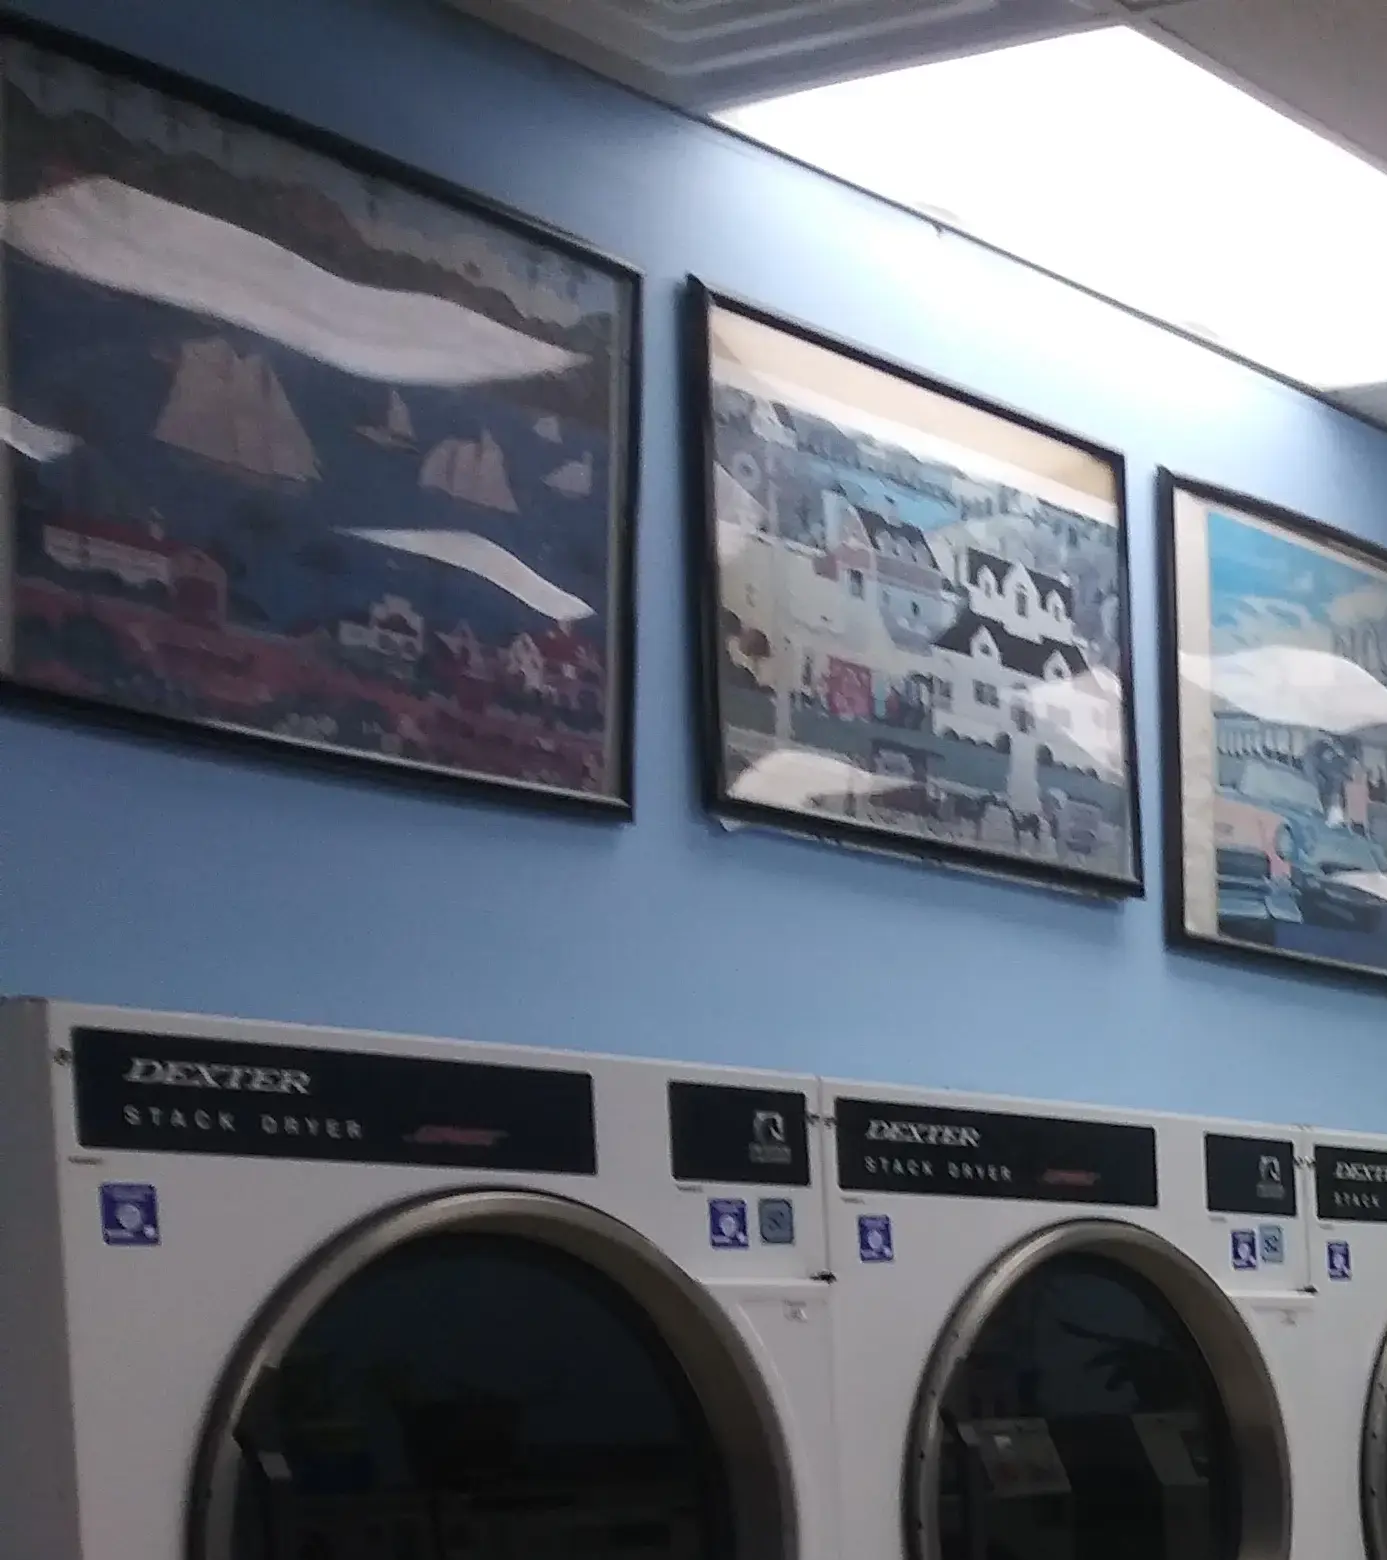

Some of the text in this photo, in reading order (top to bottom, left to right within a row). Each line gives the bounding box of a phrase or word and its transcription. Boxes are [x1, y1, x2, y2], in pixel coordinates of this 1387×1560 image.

[122, 1056, 312, 1095] DEXTER
[122, 1103, 363, 1140] STACK DRYER
[865, 1118, 982, 1148] DEXTER
[863, 1155, 1013, 1183] STACK DRYER
